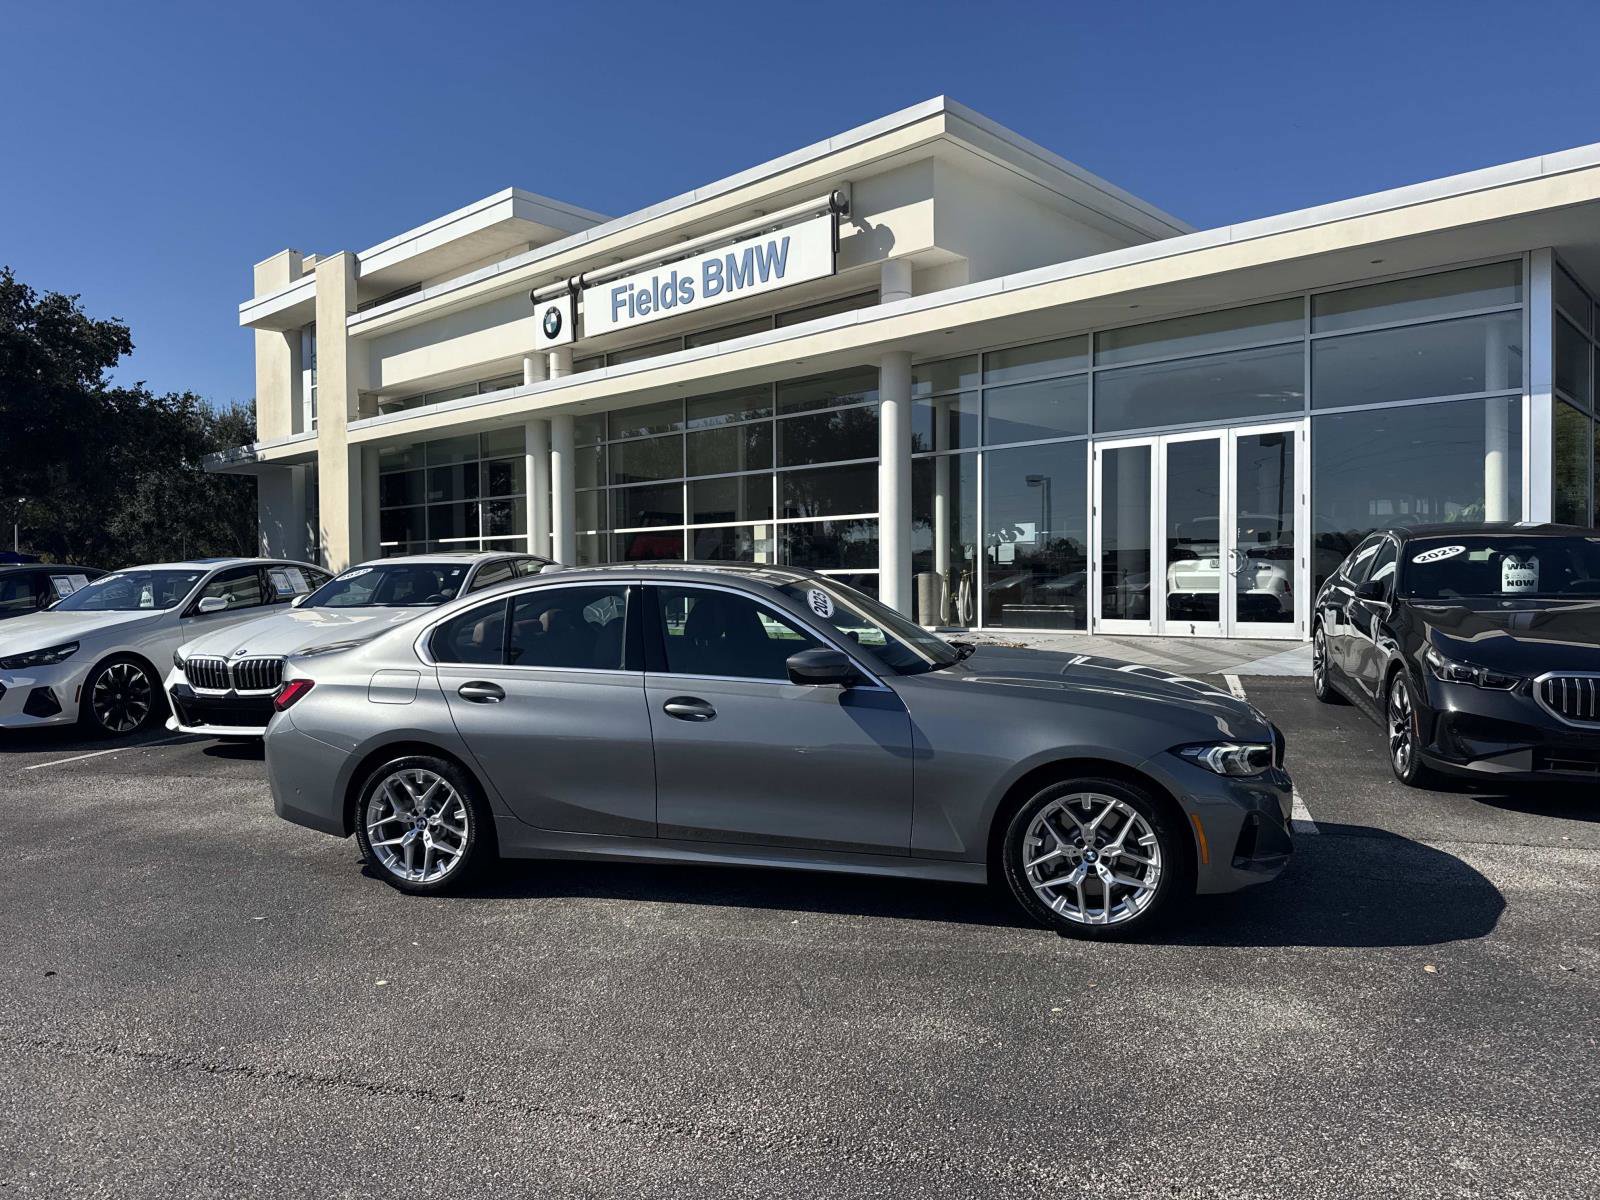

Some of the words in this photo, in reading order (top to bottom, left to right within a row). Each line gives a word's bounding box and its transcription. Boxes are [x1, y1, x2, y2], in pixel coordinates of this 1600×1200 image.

[610, 270, 695, 323] Fields
[701, 235, 791, 299] BMW
[1418, 547, 1460, 562] 2025
[812, 590, 829, 616] 2025
